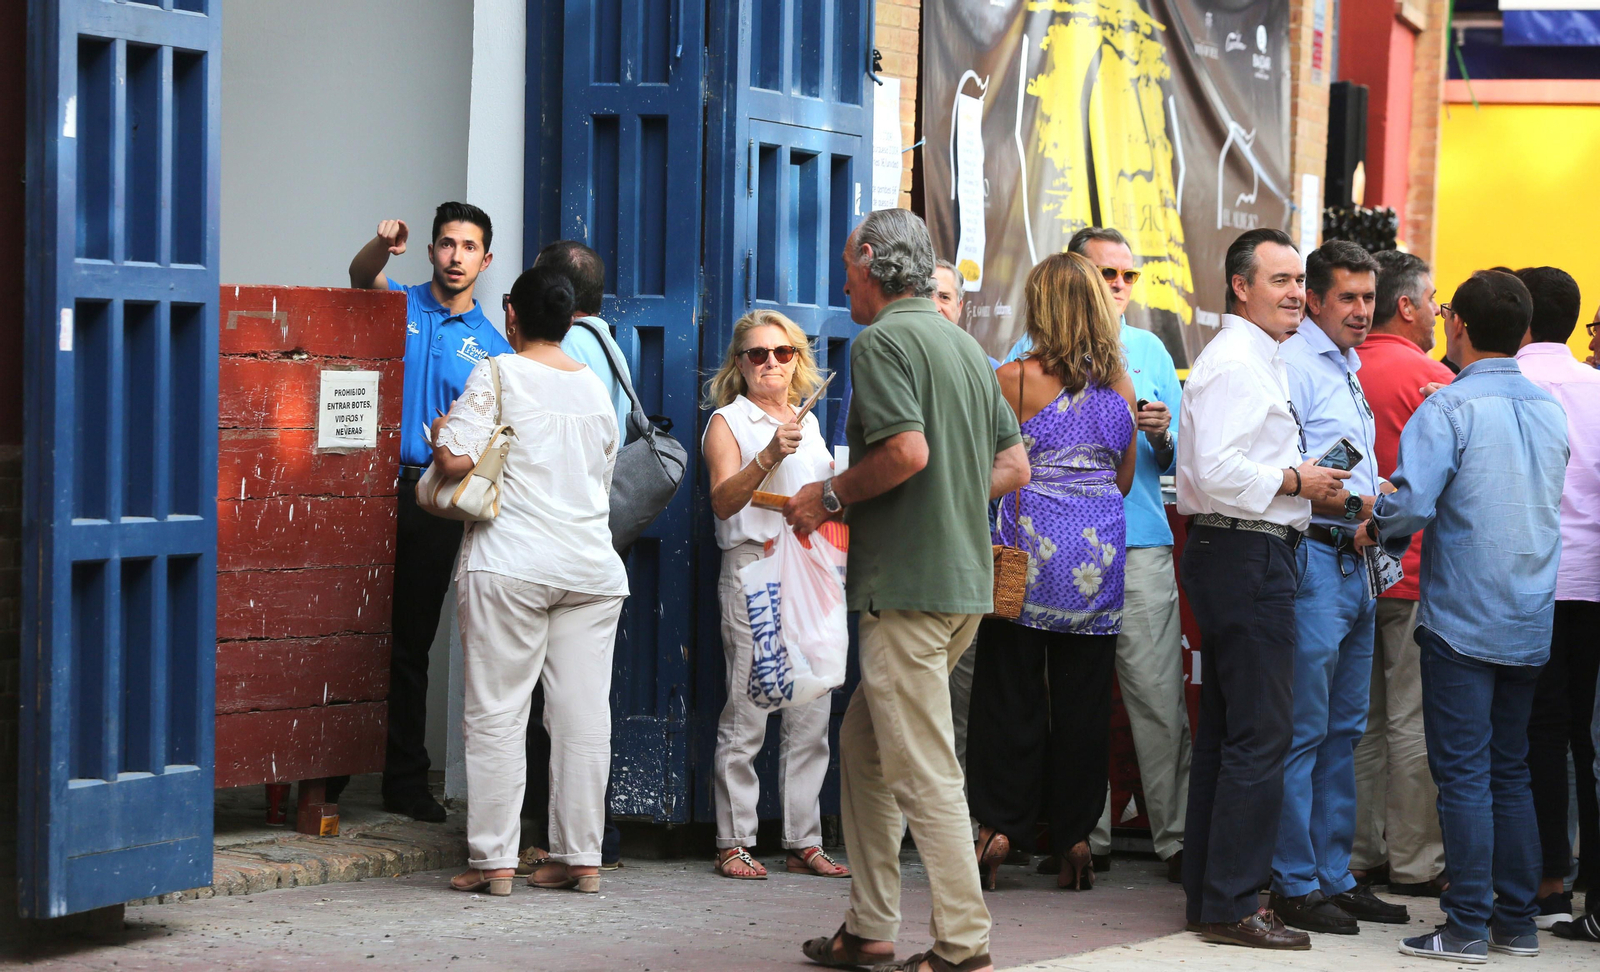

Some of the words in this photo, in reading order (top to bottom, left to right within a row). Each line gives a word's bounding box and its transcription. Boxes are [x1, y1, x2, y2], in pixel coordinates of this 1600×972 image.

[334, 388, 366, 397] PROHIBIDO
[327, 402, 351, 410] ENTRAR
[351, 401, 372, 409] BOTES,
[360, 414, 364, 422] Y
[335, 427, 363, 436] NEVERAS
